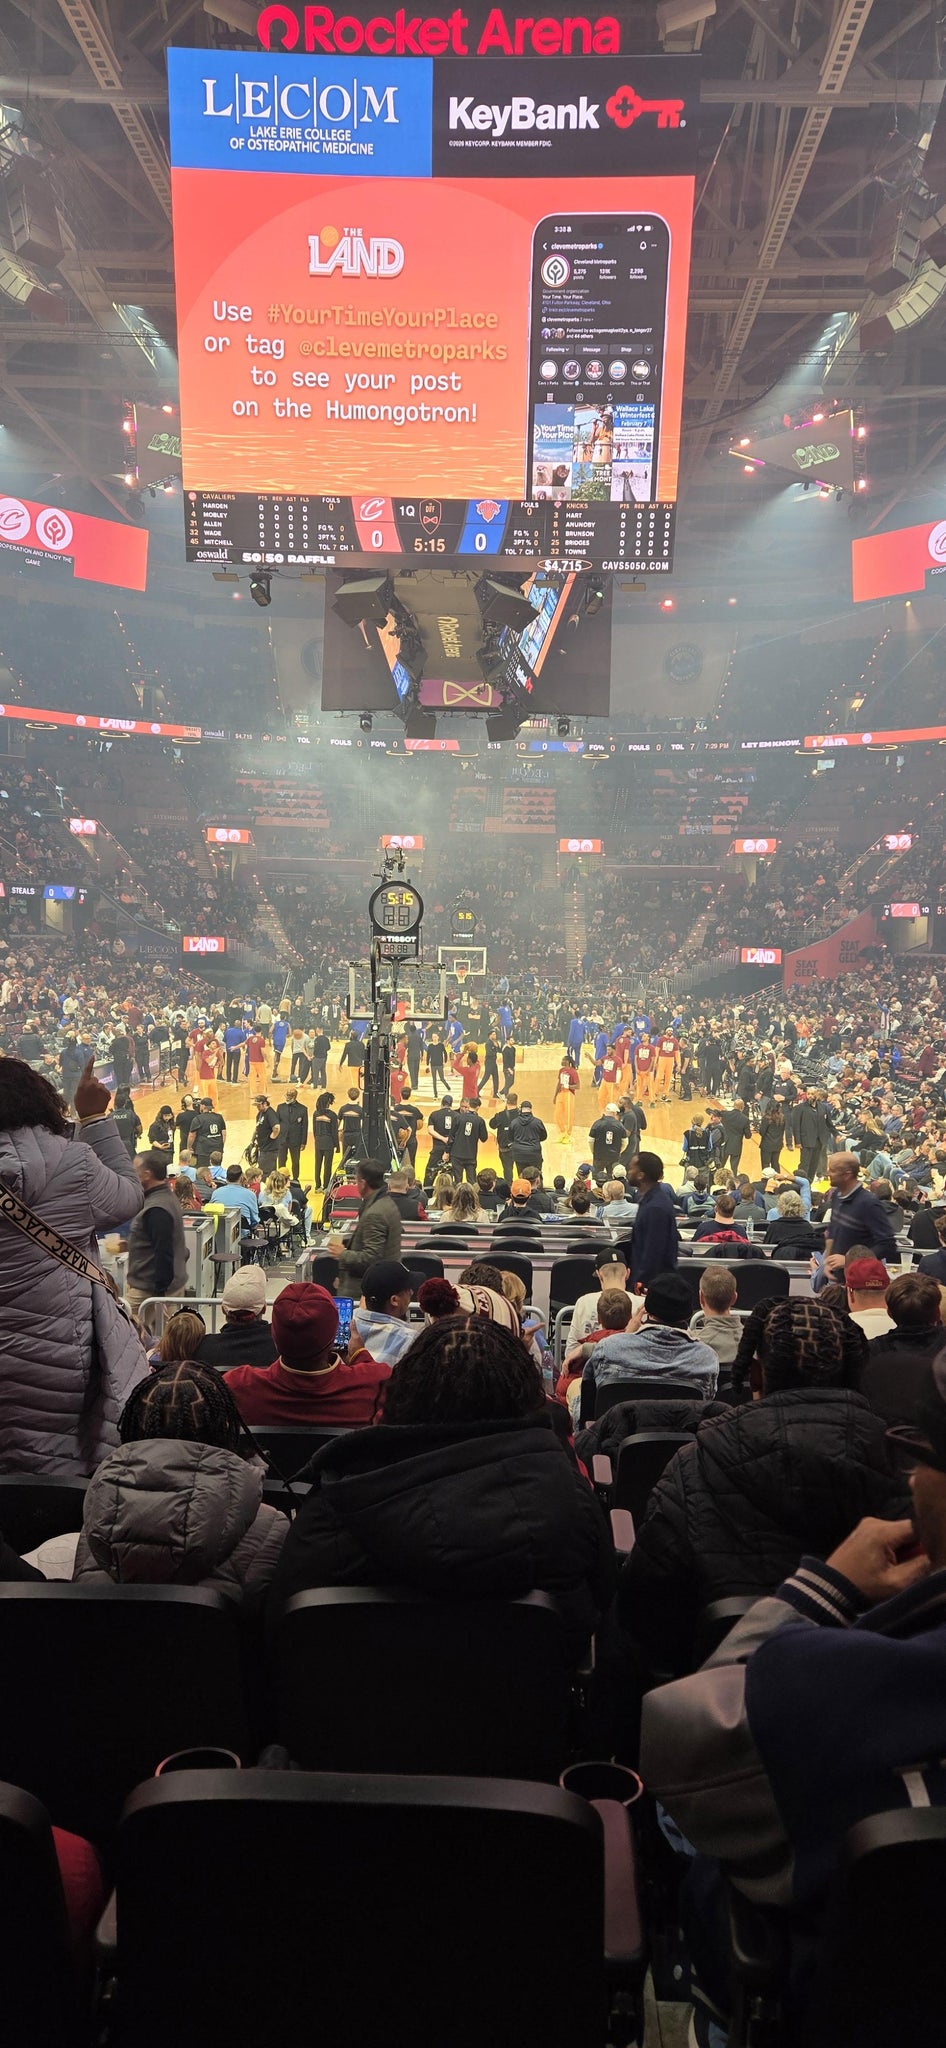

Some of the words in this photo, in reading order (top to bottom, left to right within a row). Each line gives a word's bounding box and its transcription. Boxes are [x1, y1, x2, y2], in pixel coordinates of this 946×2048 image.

[305, 6, 468, 55] Rocket
[477, 8, 620, 56] Arena
[449, 96, 600, 137] KeyBank
[250, 126, 277, 138] LAKE
[280, 127, 302, 139] ERIE
[305, 128, 351, 141] COLLEGE
[230, 137, 245, 149] OF
[247, 138, 320, 153] OSTEOPATHIC
[322, 141, 373, 155] MEDICINE
[343, 228, 362, 236] THE
[308, 235, 405, 278] LAND
[213, 300, 252, 322] Use
[268, 303, 498, 329] #YourTimeYourPlace
[204, 336, 230, 352] or
[246, 334, 285, 360] tag
[299, 336, 507, 364] @clevemetroparks
[250, 366, 276, 386] to
[292, 369, 330, 388] see
[344, 371, 396, 394] your
[410, 372, 462, 395] post
[232, 399, 258, 417] on
[273, 397, 311, 418] the
[326, 399, 477, 426] Humongotron!
[540, 424, 556, 432] Your
[557, 424, 574, 432] Time
[792, 443, 840, 469] LAND
[203, 511, 228, 519] MOBLEY
[399, 505, 415, 517] 1Q
[203, 520, 222, 528] ALLEN
[203, 529, 222, 537] WADE
[317, 533, 329, 541] 3PT
[371, 530, 383, 548] 0
[204, 538, 233, 546] MITCHELL
[414, 538, 445, 552] 5:15
[474, 533, 487, 551] 0
[44, 552, 62, 560] ENJOY
[197, 548, 228, 559] oswald
[287, 554, 336, 564] RAFFLE
[24, 558, 40, 566] GAME
[544, 560, 582, 573] $4,715
[602, 561, 669, 571] CAVS5050.COM
[297, 736, 310, 744] TOL
[371, 740, 386, 748] FG%
[515, 742, 527, 750] 1Q
[589, 743, 604, 751] FG%
[11, 886, 35, 895] STEALS
[387, 892, 414, 905] 5:15
[189, 937, 219, 952] LAND
[387, 935, 417, 943] TISSOT
[841, 940, 860, 951] SEAT
[747, 949, 776, 963] LAND
[796, 960, 818, 968] SEAT
[794, 968, 818, 977] GEEK
[52, 1240, 89, 1273] MARC
